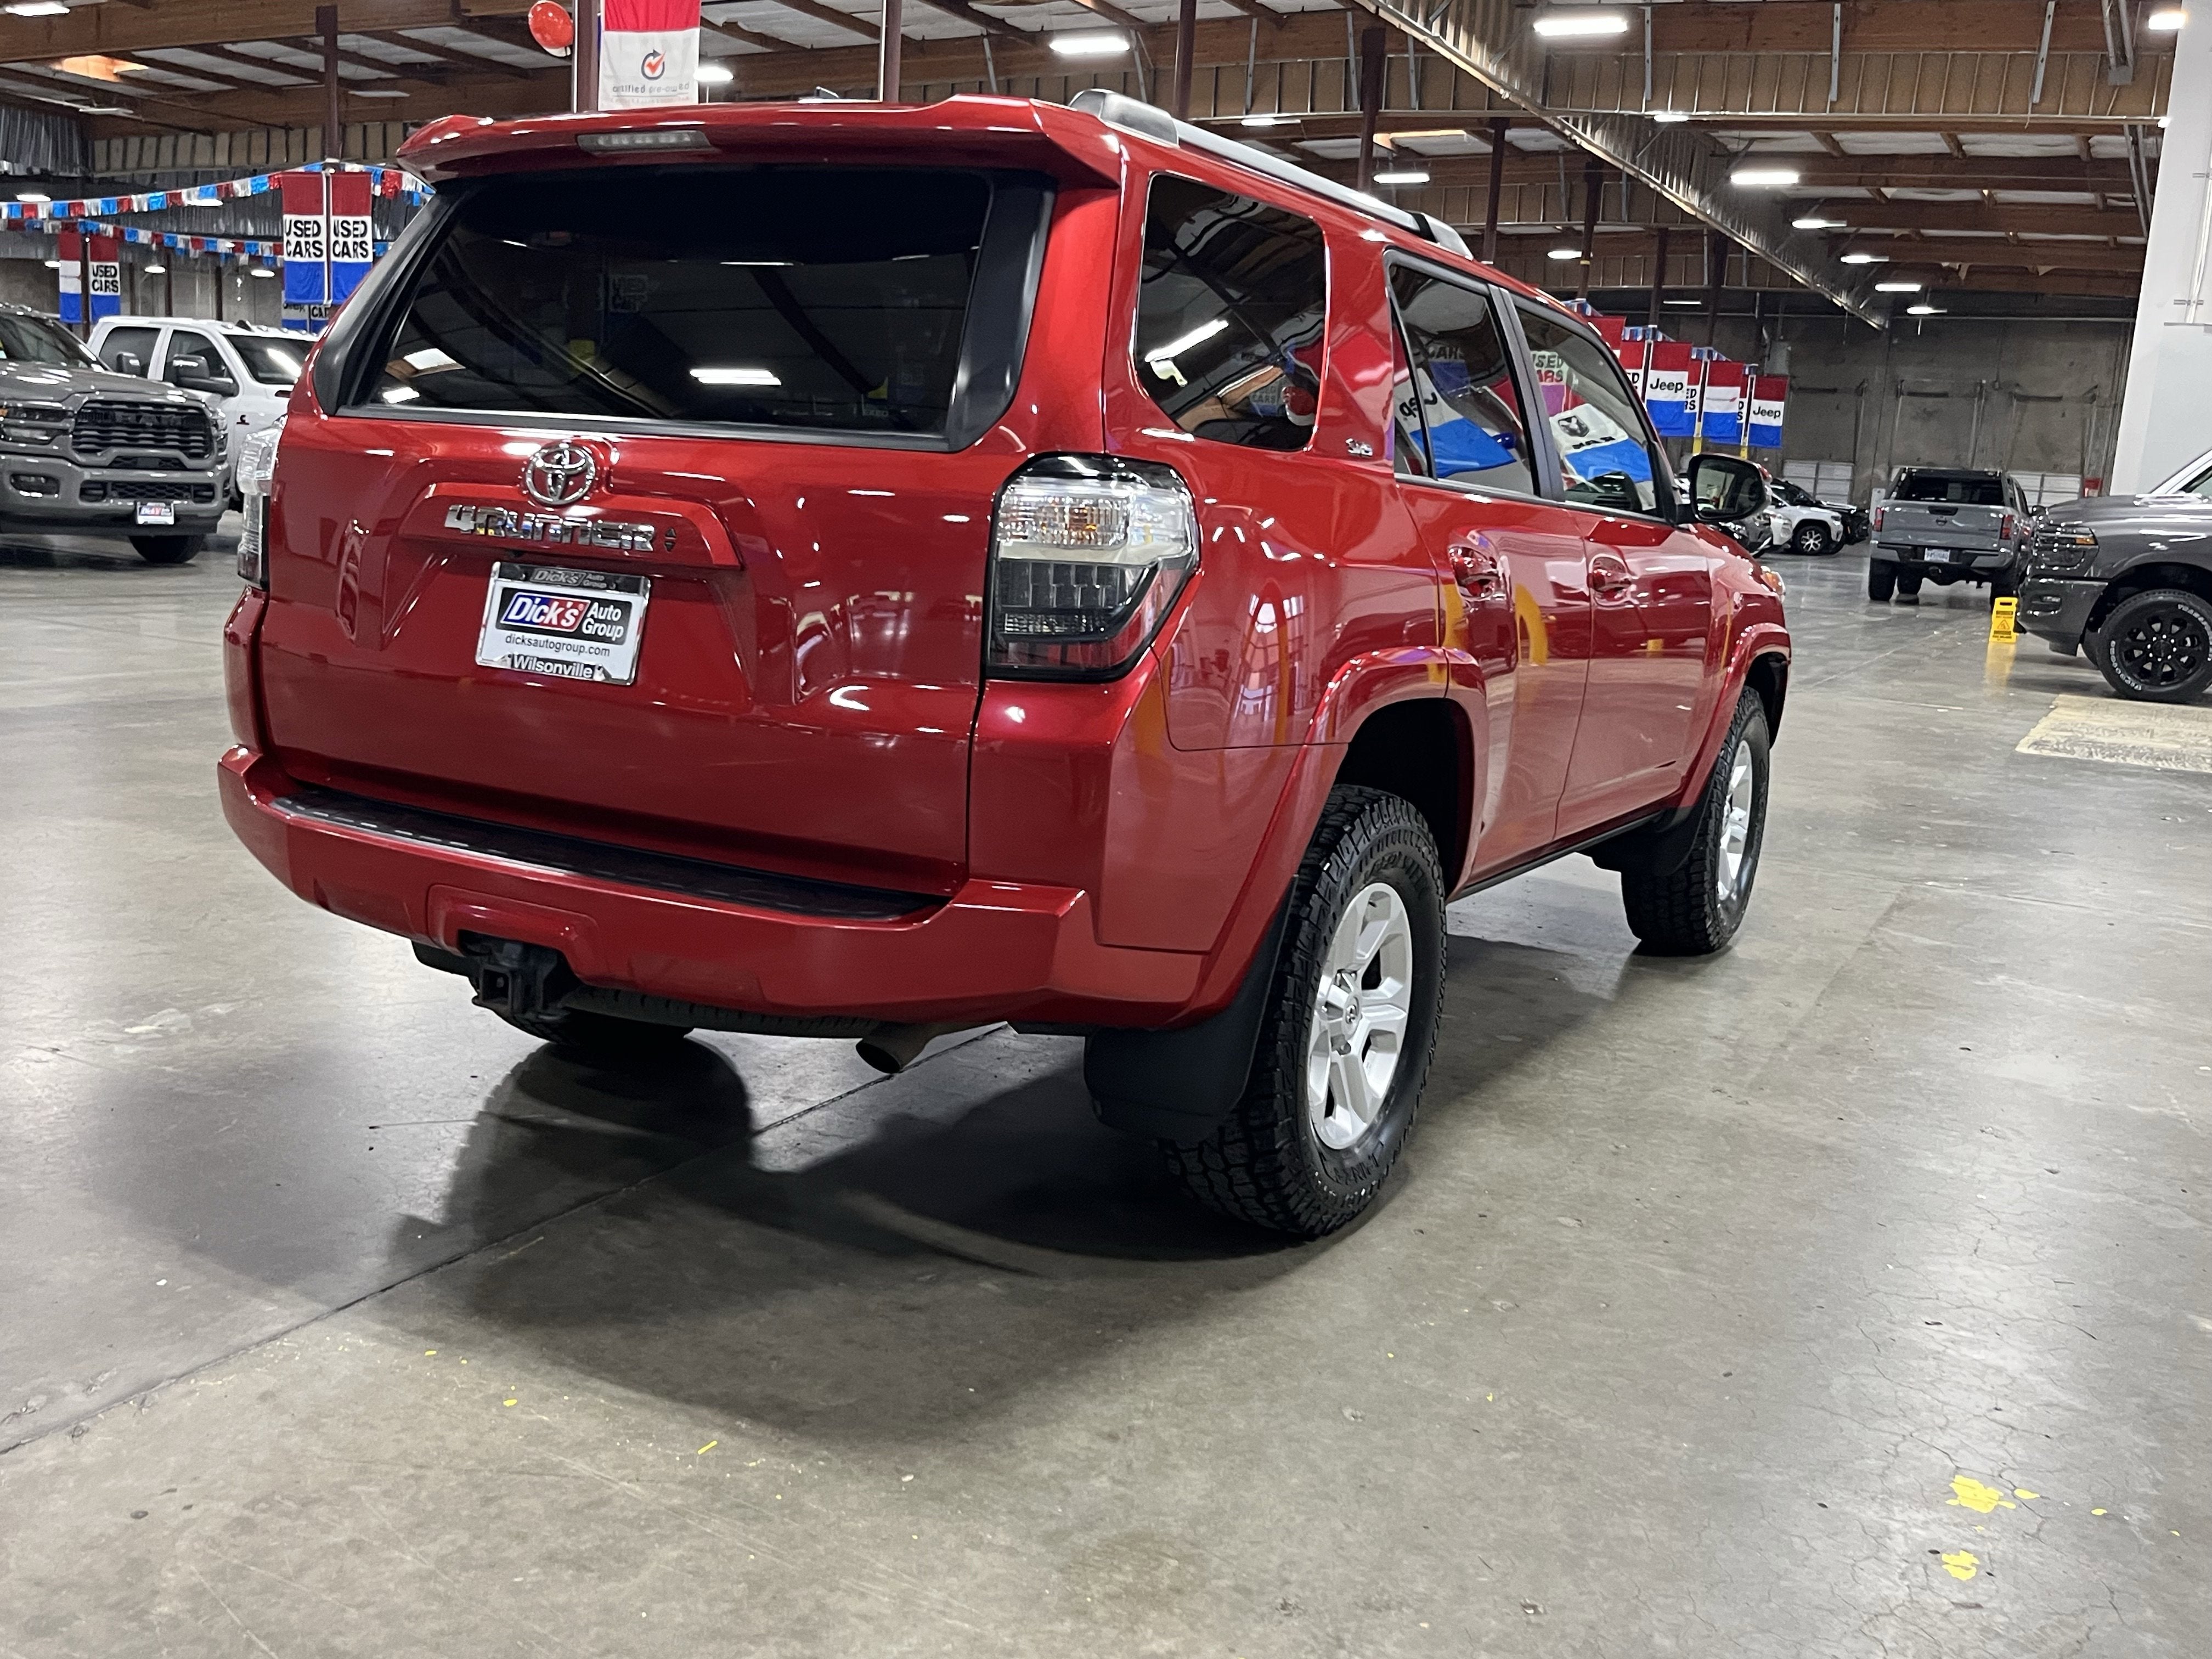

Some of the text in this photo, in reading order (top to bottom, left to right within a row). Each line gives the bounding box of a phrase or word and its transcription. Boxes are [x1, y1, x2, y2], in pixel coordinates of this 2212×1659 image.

[285, 219, 321, 238] USED
[334, 219, 368, 239] USED
[285, 239, 324, 258] CARS
[332, 240, 369, 258] CARS
[92, 264, 117, 278] USED
[1650, 377, 1684, 393] Jeep
[1753, 406, 1781, 419] Jeep
[507, 596, 580, 628] Dick's
[587, 602, 622, 622] Auto
[582, 619, 624, 641] Group
[505, 633, 611, 657] dicksautogroup.com
[512, 654, 594, 679] Wilsonville
